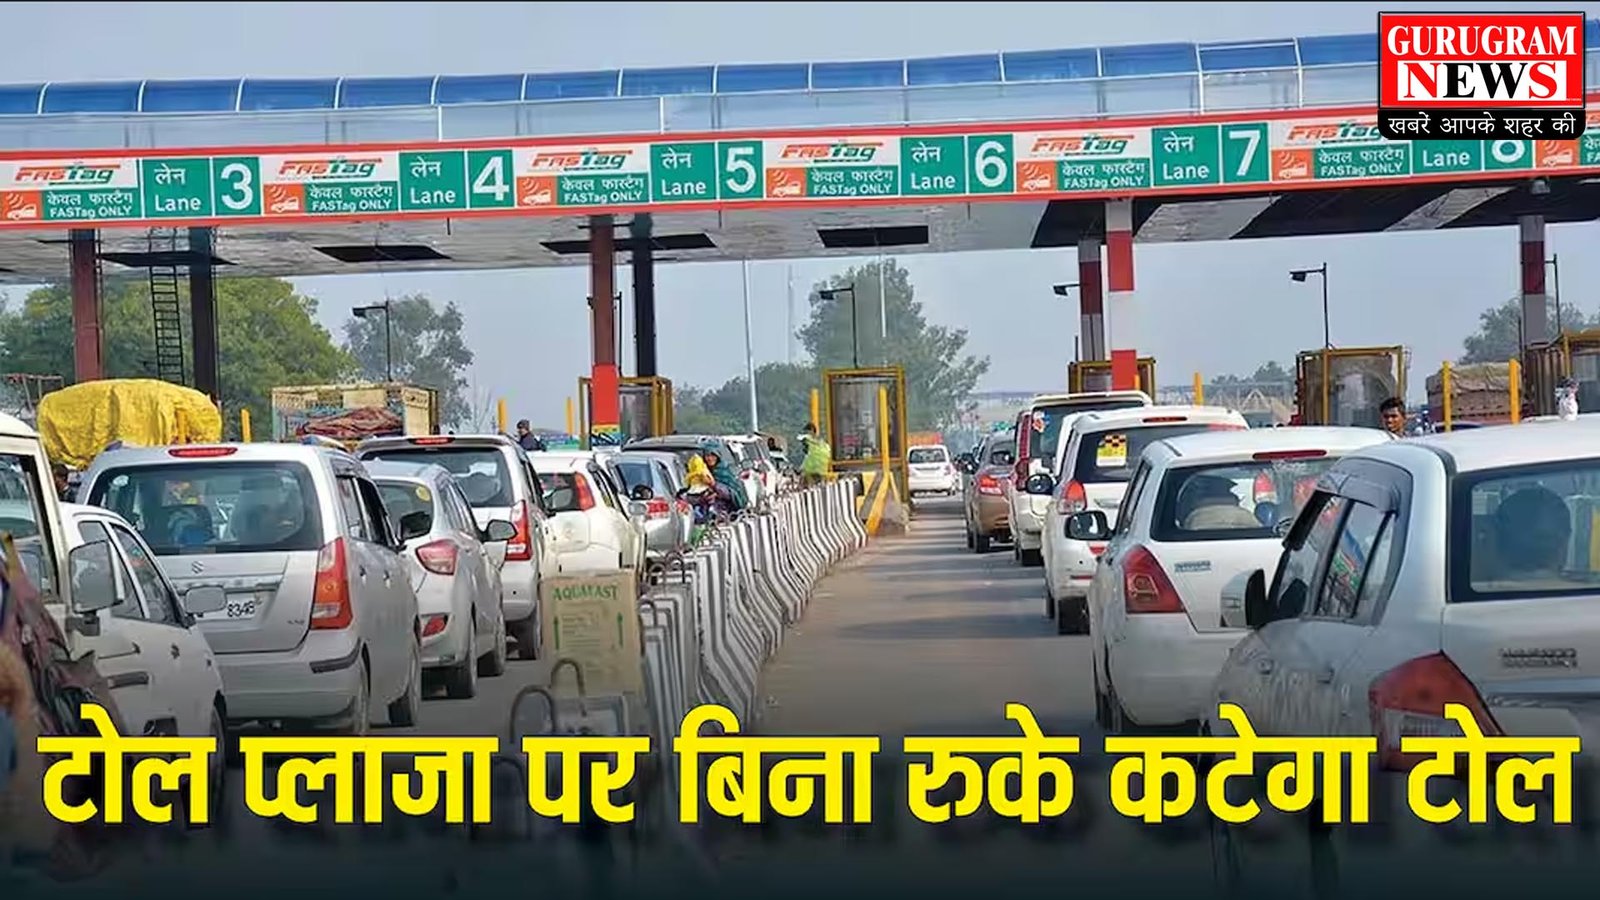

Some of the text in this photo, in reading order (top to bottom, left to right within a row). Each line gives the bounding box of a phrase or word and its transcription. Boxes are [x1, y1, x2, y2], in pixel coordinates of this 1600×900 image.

[1162, 131, 1193, 153] लेन
[661, 148, 692, 169] लेन
[911, 142, 941, 163] लेन
[1229, 130, 1261, 176] 7
[1320, 149, 1352, 163] केवल
[1423, 150, 1471, 167] Lane
[410, 156, 441, 178] लेन
[727, 148, 757, 193] 5
[975, 141, 1007, 187] 6
[1062, 161, 1095, 176] केवल
[1163, 163, 1209, 180] Lane
[1321, 163, 1402, 177] FASTag ONLY
[155, 164, 186, 184] लेन
[473, 157, 510, 201] 4
[811, 168, 844, 183] केवल
[911, 173, 956, 190] Lane
[1064, 176, 1144, 189] FASTag ONLY
[221, 163, 253, 210] 3
[309, 184, 342, 199] केवल
[562, 177, 595, 191] केवल
[662, 179, 706, 196] Lane
[813, 183, 892, 196] FASTag ONLY
[48, 190, 81, 205] केवल
[156, 195, 201, 212] Lane
[411, 188, 456, 204] Lane
[564, 191, 643, 204] FASTag ONLY
[50, 206, 131, 219] FASTag ONLY
[312, 199, 392, 212] FASTag ONLY
